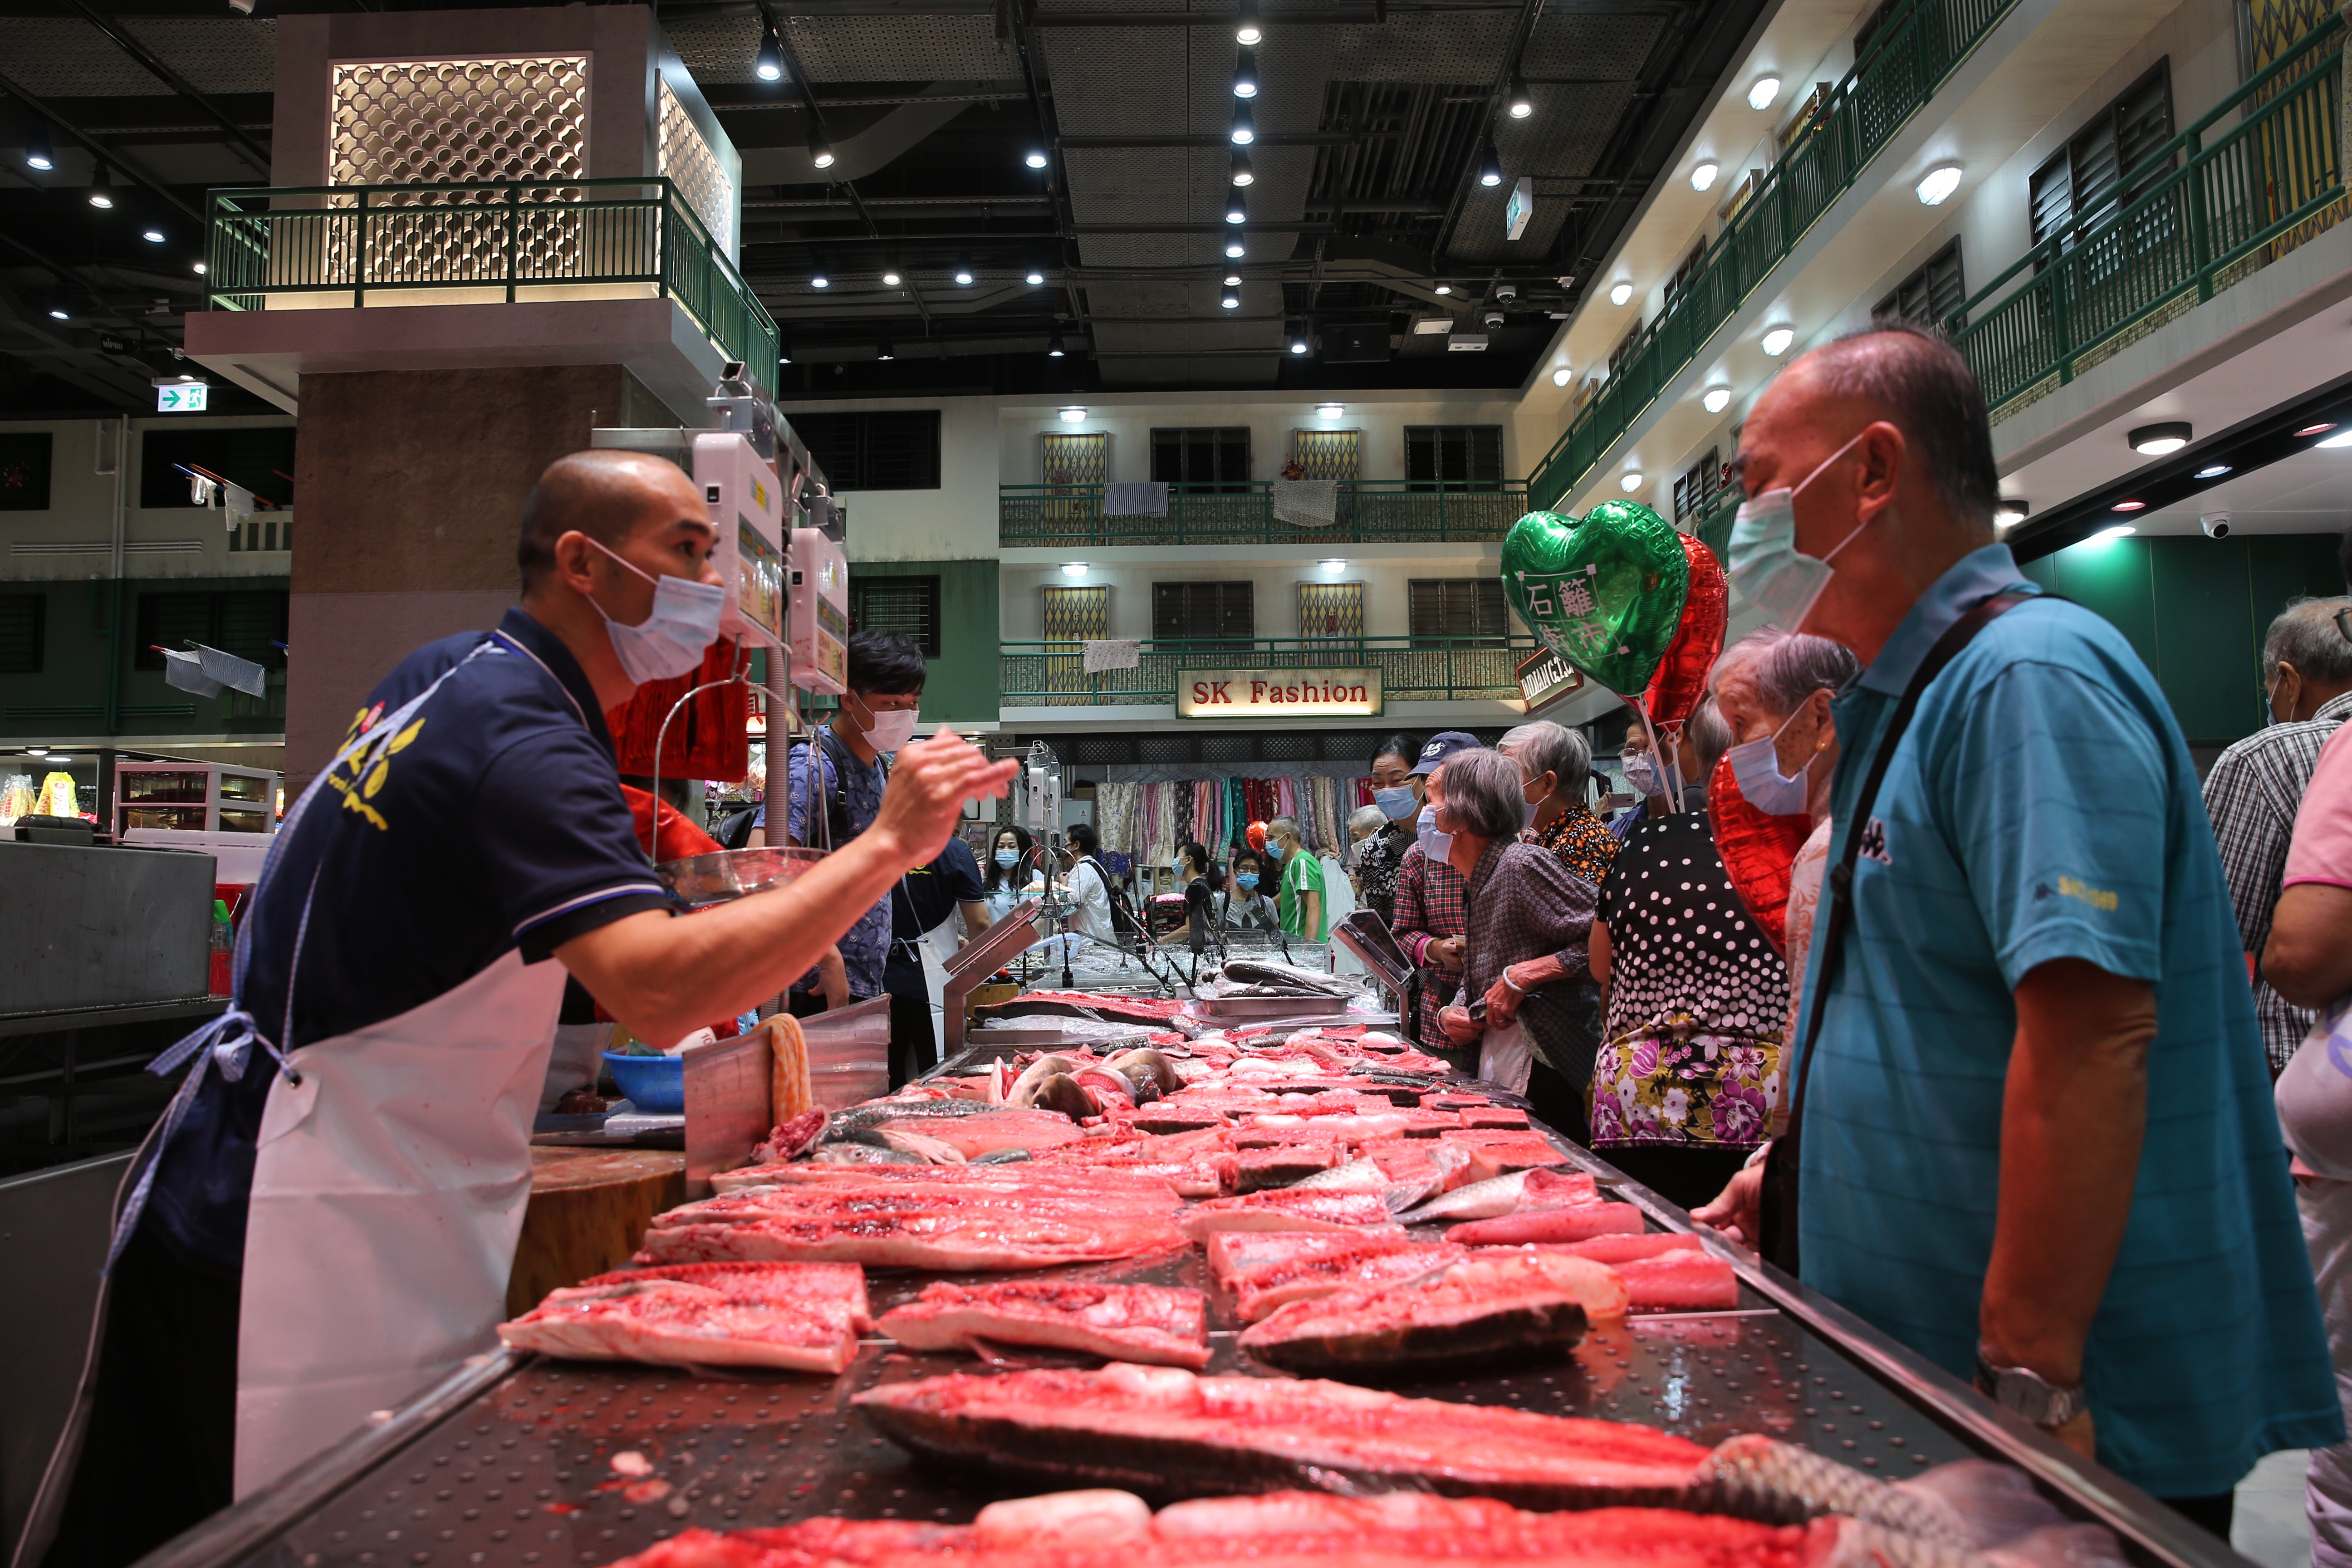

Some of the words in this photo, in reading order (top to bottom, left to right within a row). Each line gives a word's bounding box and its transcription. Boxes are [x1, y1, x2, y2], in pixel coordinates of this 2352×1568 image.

[1526, 578, 1597, 617] 石籬
[1193, 681, 1232, 704] SK
[1250, 680, 1367, 703] Fashion
